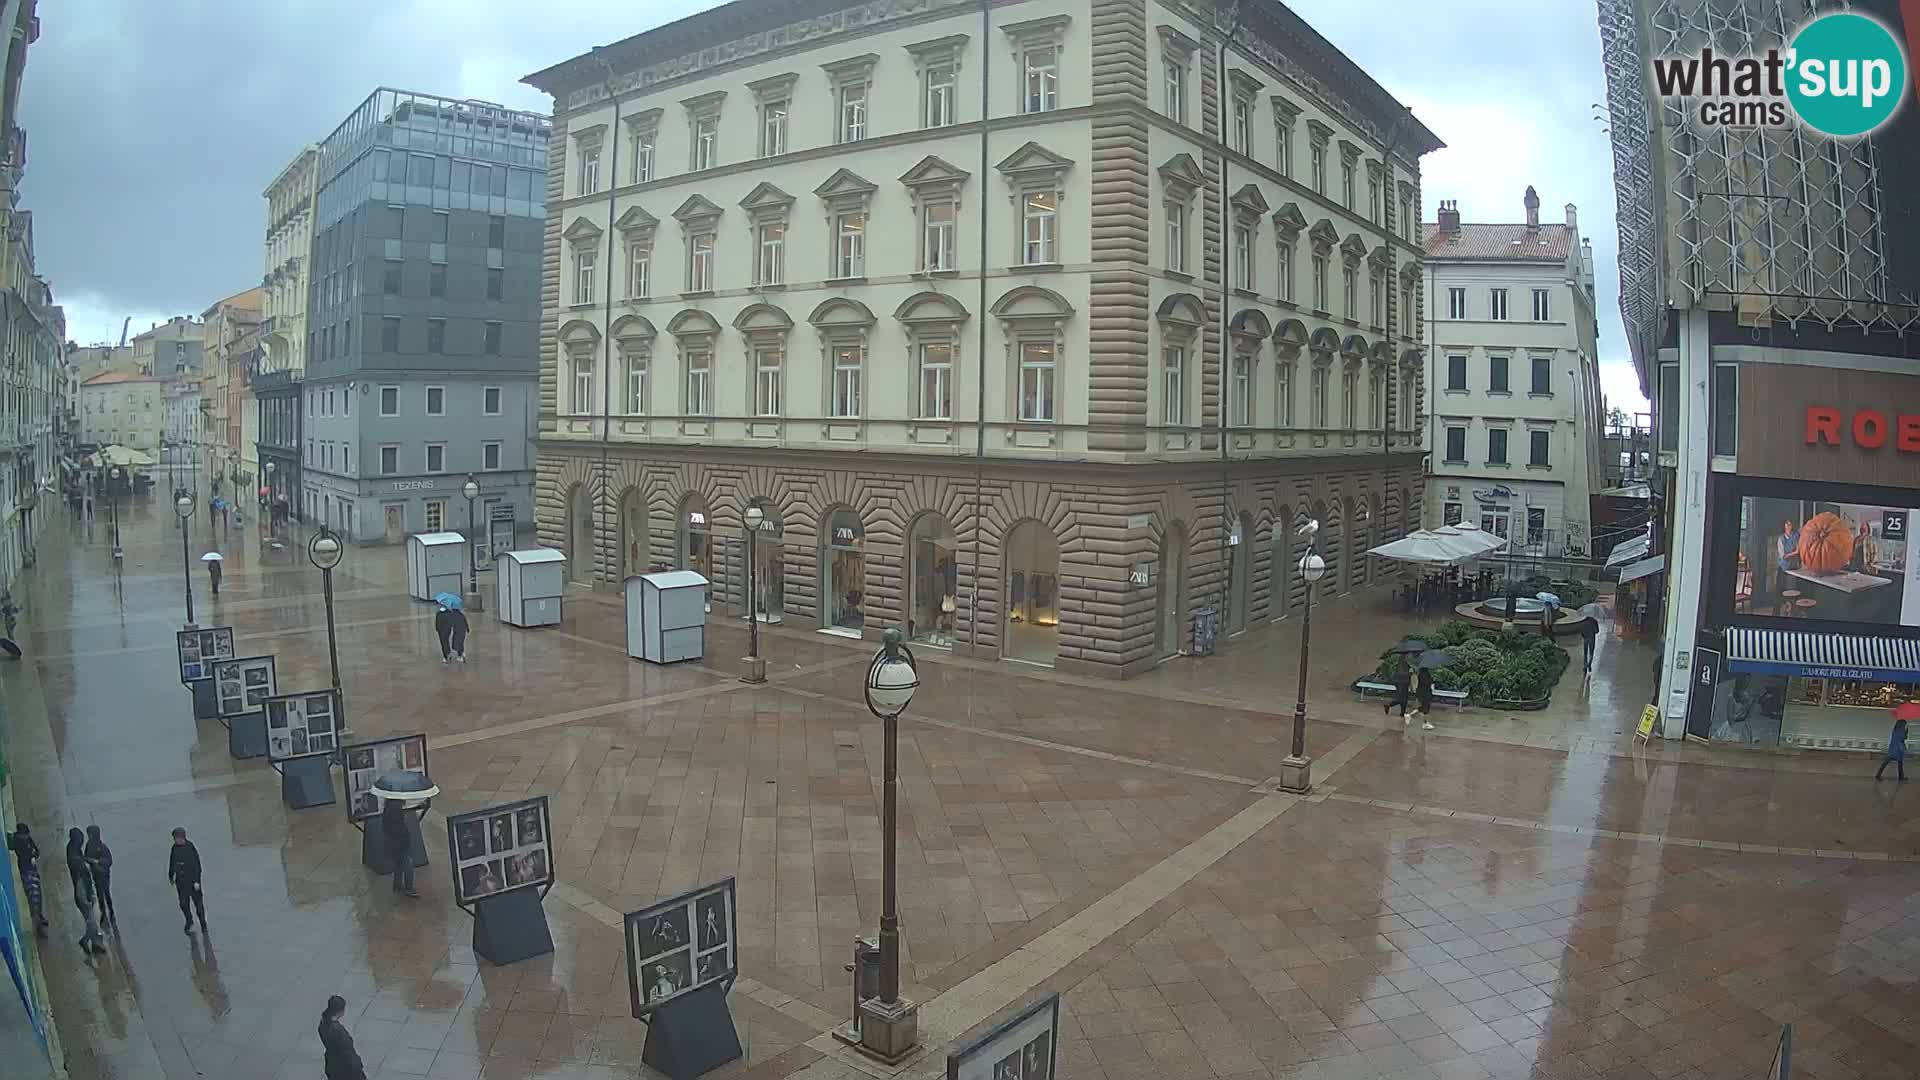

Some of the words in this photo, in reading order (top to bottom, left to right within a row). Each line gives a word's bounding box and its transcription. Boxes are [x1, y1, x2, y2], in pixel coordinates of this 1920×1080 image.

[392, 480, 434, 490] TEZENIS
[1887, 517, 1902, 531] 25
[1849, 670, 1873, 679] GELATO
